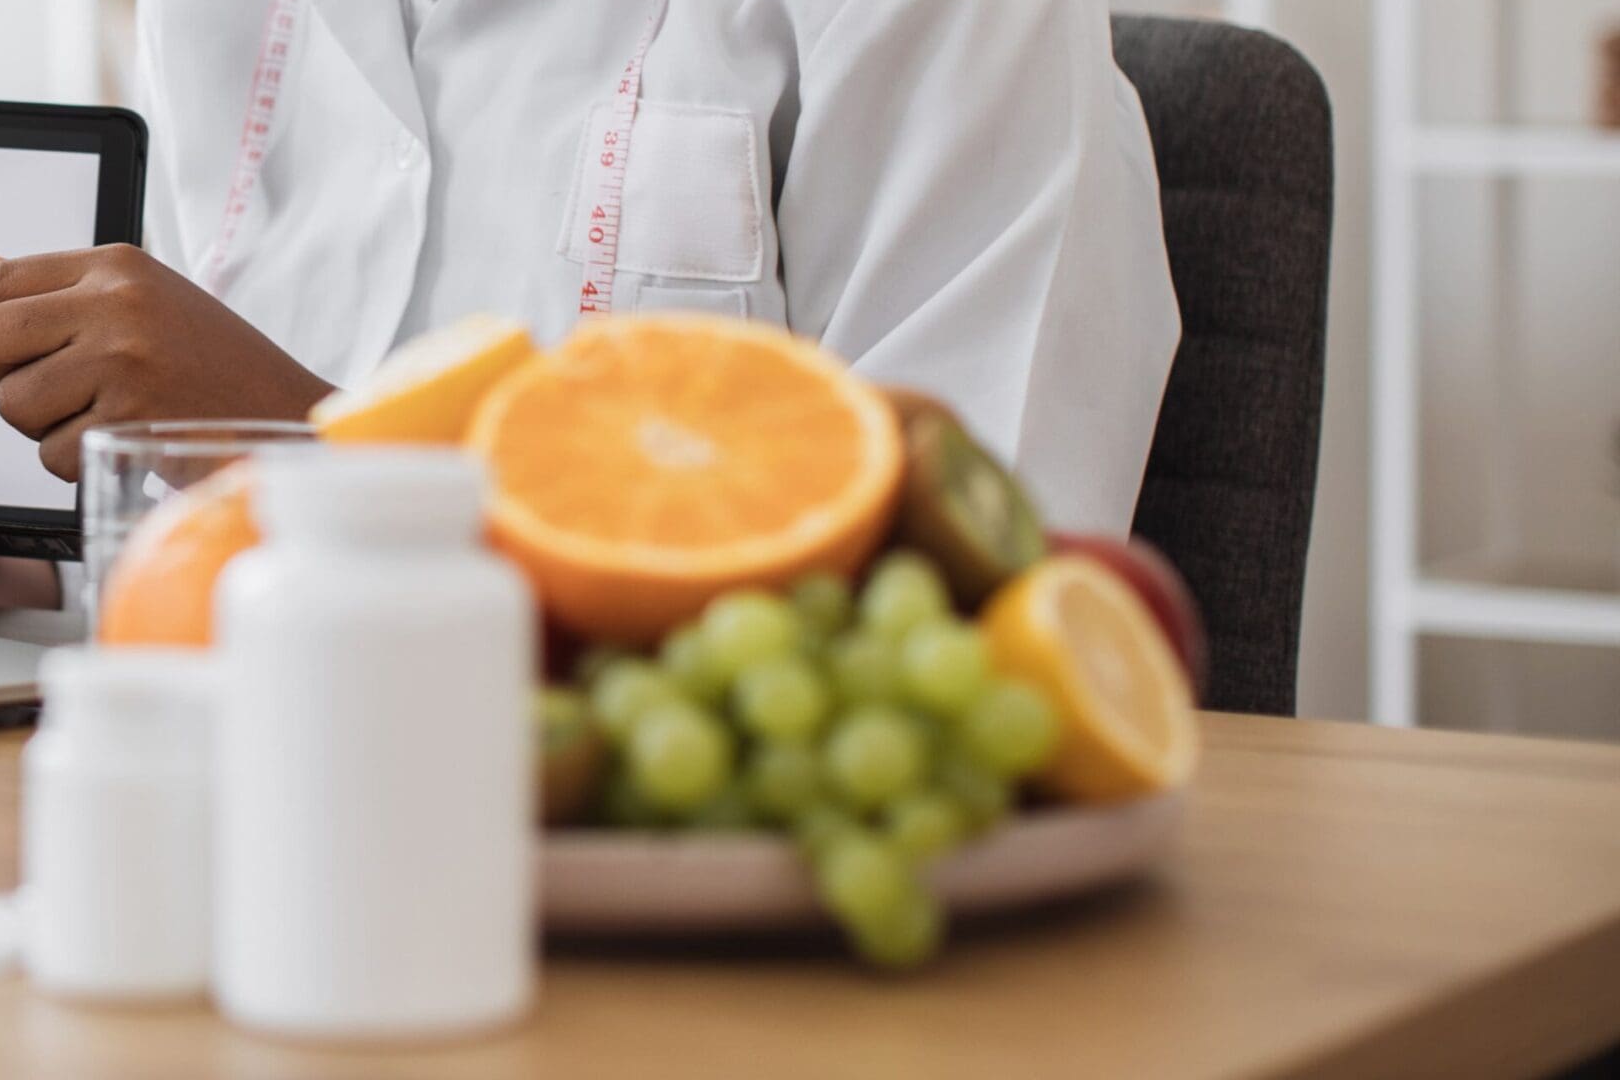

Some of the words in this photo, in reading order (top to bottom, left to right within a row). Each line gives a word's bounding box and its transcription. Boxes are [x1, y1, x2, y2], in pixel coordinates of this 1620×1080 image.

[599, 130, 619, 167] 39
[588, 204, 607, 244] 40
[579, 280, 599, 314] 41
